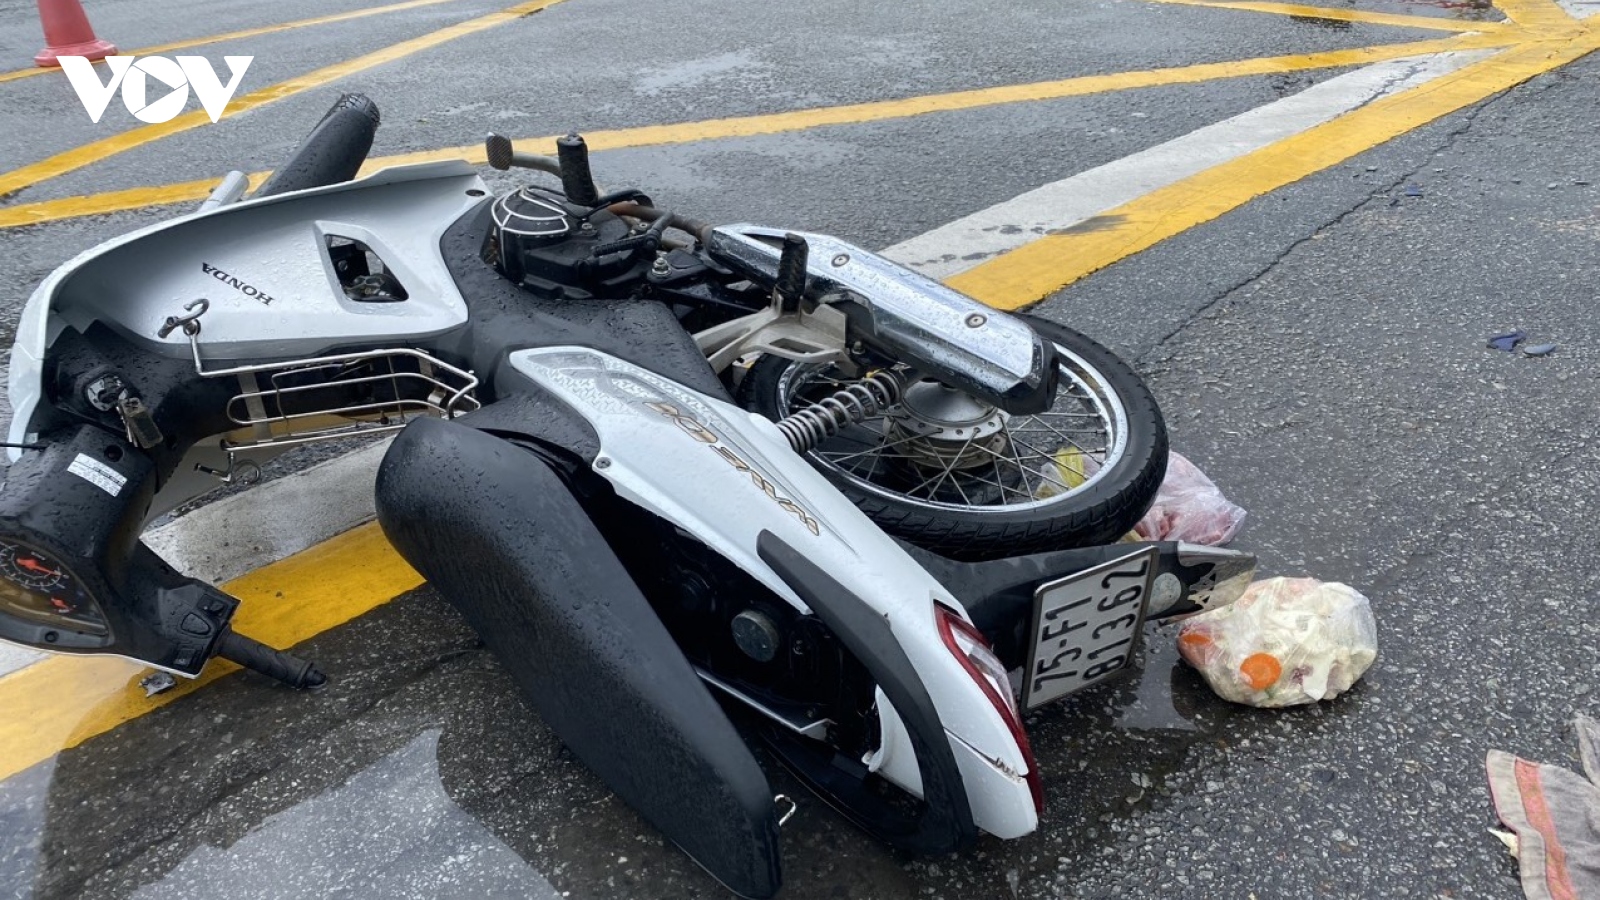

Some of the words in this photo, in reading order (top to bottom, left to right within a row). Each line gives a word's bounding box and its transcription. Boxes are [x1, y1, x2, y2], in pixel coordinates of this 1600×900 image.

[202, 262, 275, 305] HONDA
[709, 444, 820, 536] WAVE
[1033, 596, 1093, 693] 75-F1
[1082, 560, 1149, 681] 813.62
